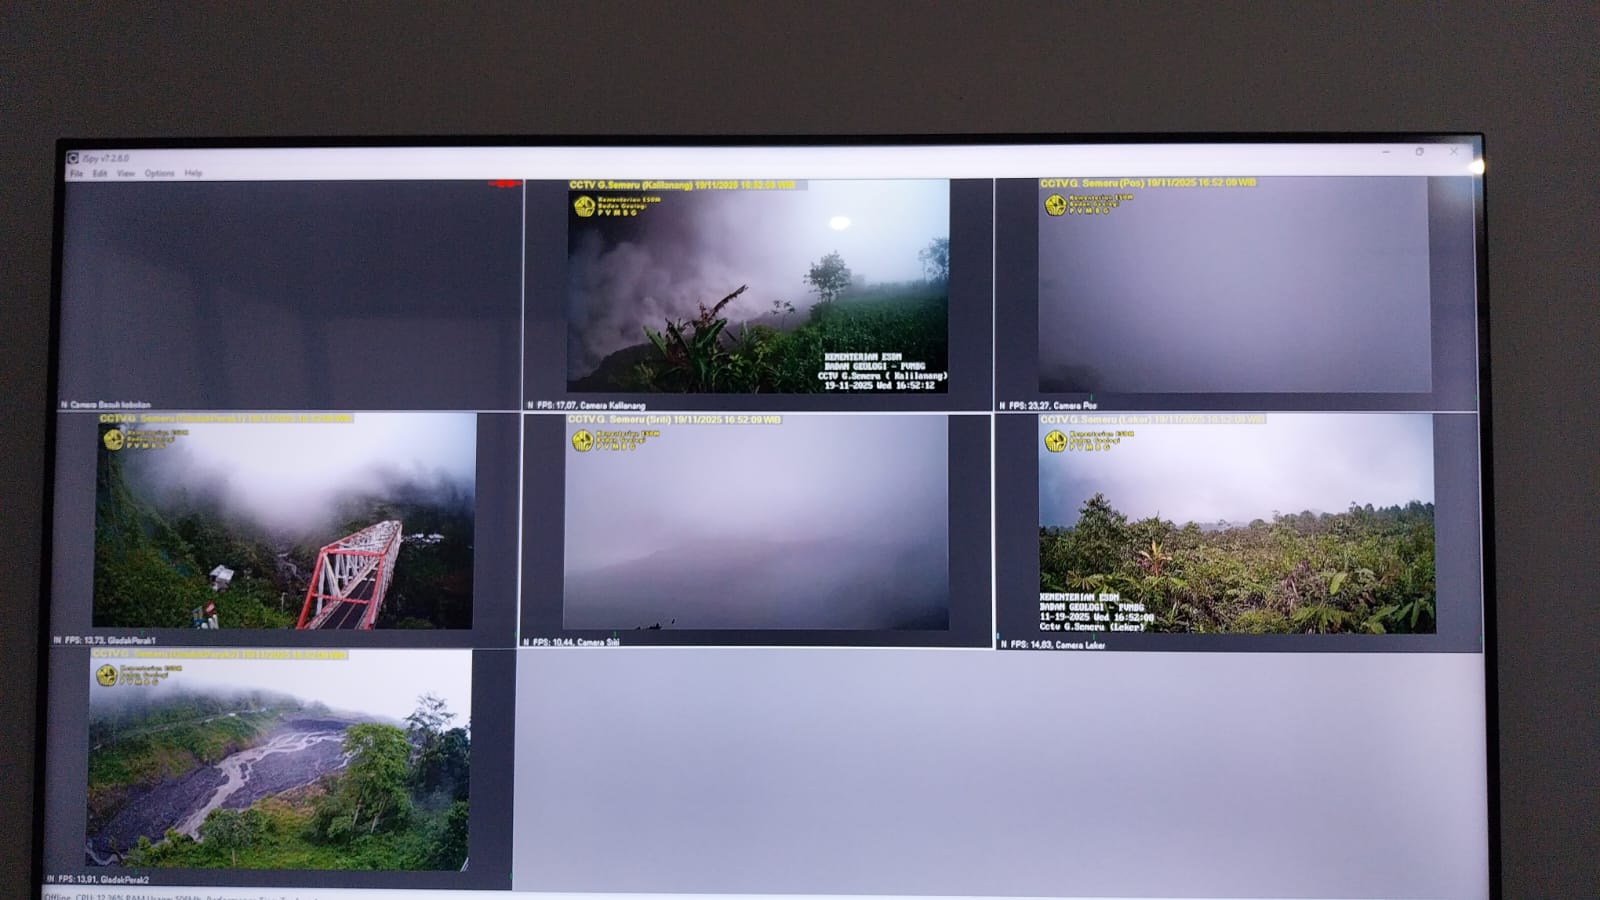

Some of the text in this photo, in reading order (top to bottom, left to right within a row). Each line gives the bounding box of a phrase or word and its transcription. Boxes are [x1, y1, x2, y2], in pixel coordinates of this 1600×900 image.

[82, 154, 98, 163] iSpy
[145, 170, 174, 179] Options
[185, 169, 203, 178] Help
[569, 181, 595, 189] CCTV
[1041, 179, 1068, 188] CCTV
[1082, 180, 1119, 188] Semeru
[1119, 179, 1145, 190] (Pos)
[825, 353, 902, 361] KEMENTERIAN ESDM
[853, 362, 887, 370] GEOLOGI
[825, 382, 935, 390] 19-11-2025 Wed 16:52:12
[100, 414, 127, 422] CCTV
[568, 415, 596, 423] CCTV
[675, 415, 722, 424] 19/11/2025
[1041, 415, 1069, 424] CCTV
[1039, 592, 1095, 600] KEMENTERIAN
[1039, 603, 1065, 611] BADAN
[1069, 603, 1104, 611] GEOLOGI
[1118, 603, 1144, 611] PVMBG
[1040, 613, 1090, 621] 11-19-2025
[1093, 613, 1109, 621] Wed
[1064, 622, 1104, 631] G.Semeru
[1110, 622, 1144, 632] (Leker)
[533, 638, 551, 646] FPS:
[578, 638, 605, 646] Camera
[1056, 641, 1083, 649] Camera
[59, 875, 76, 883] FPS:
[101, 876, 149, 885] GladakPerak2
